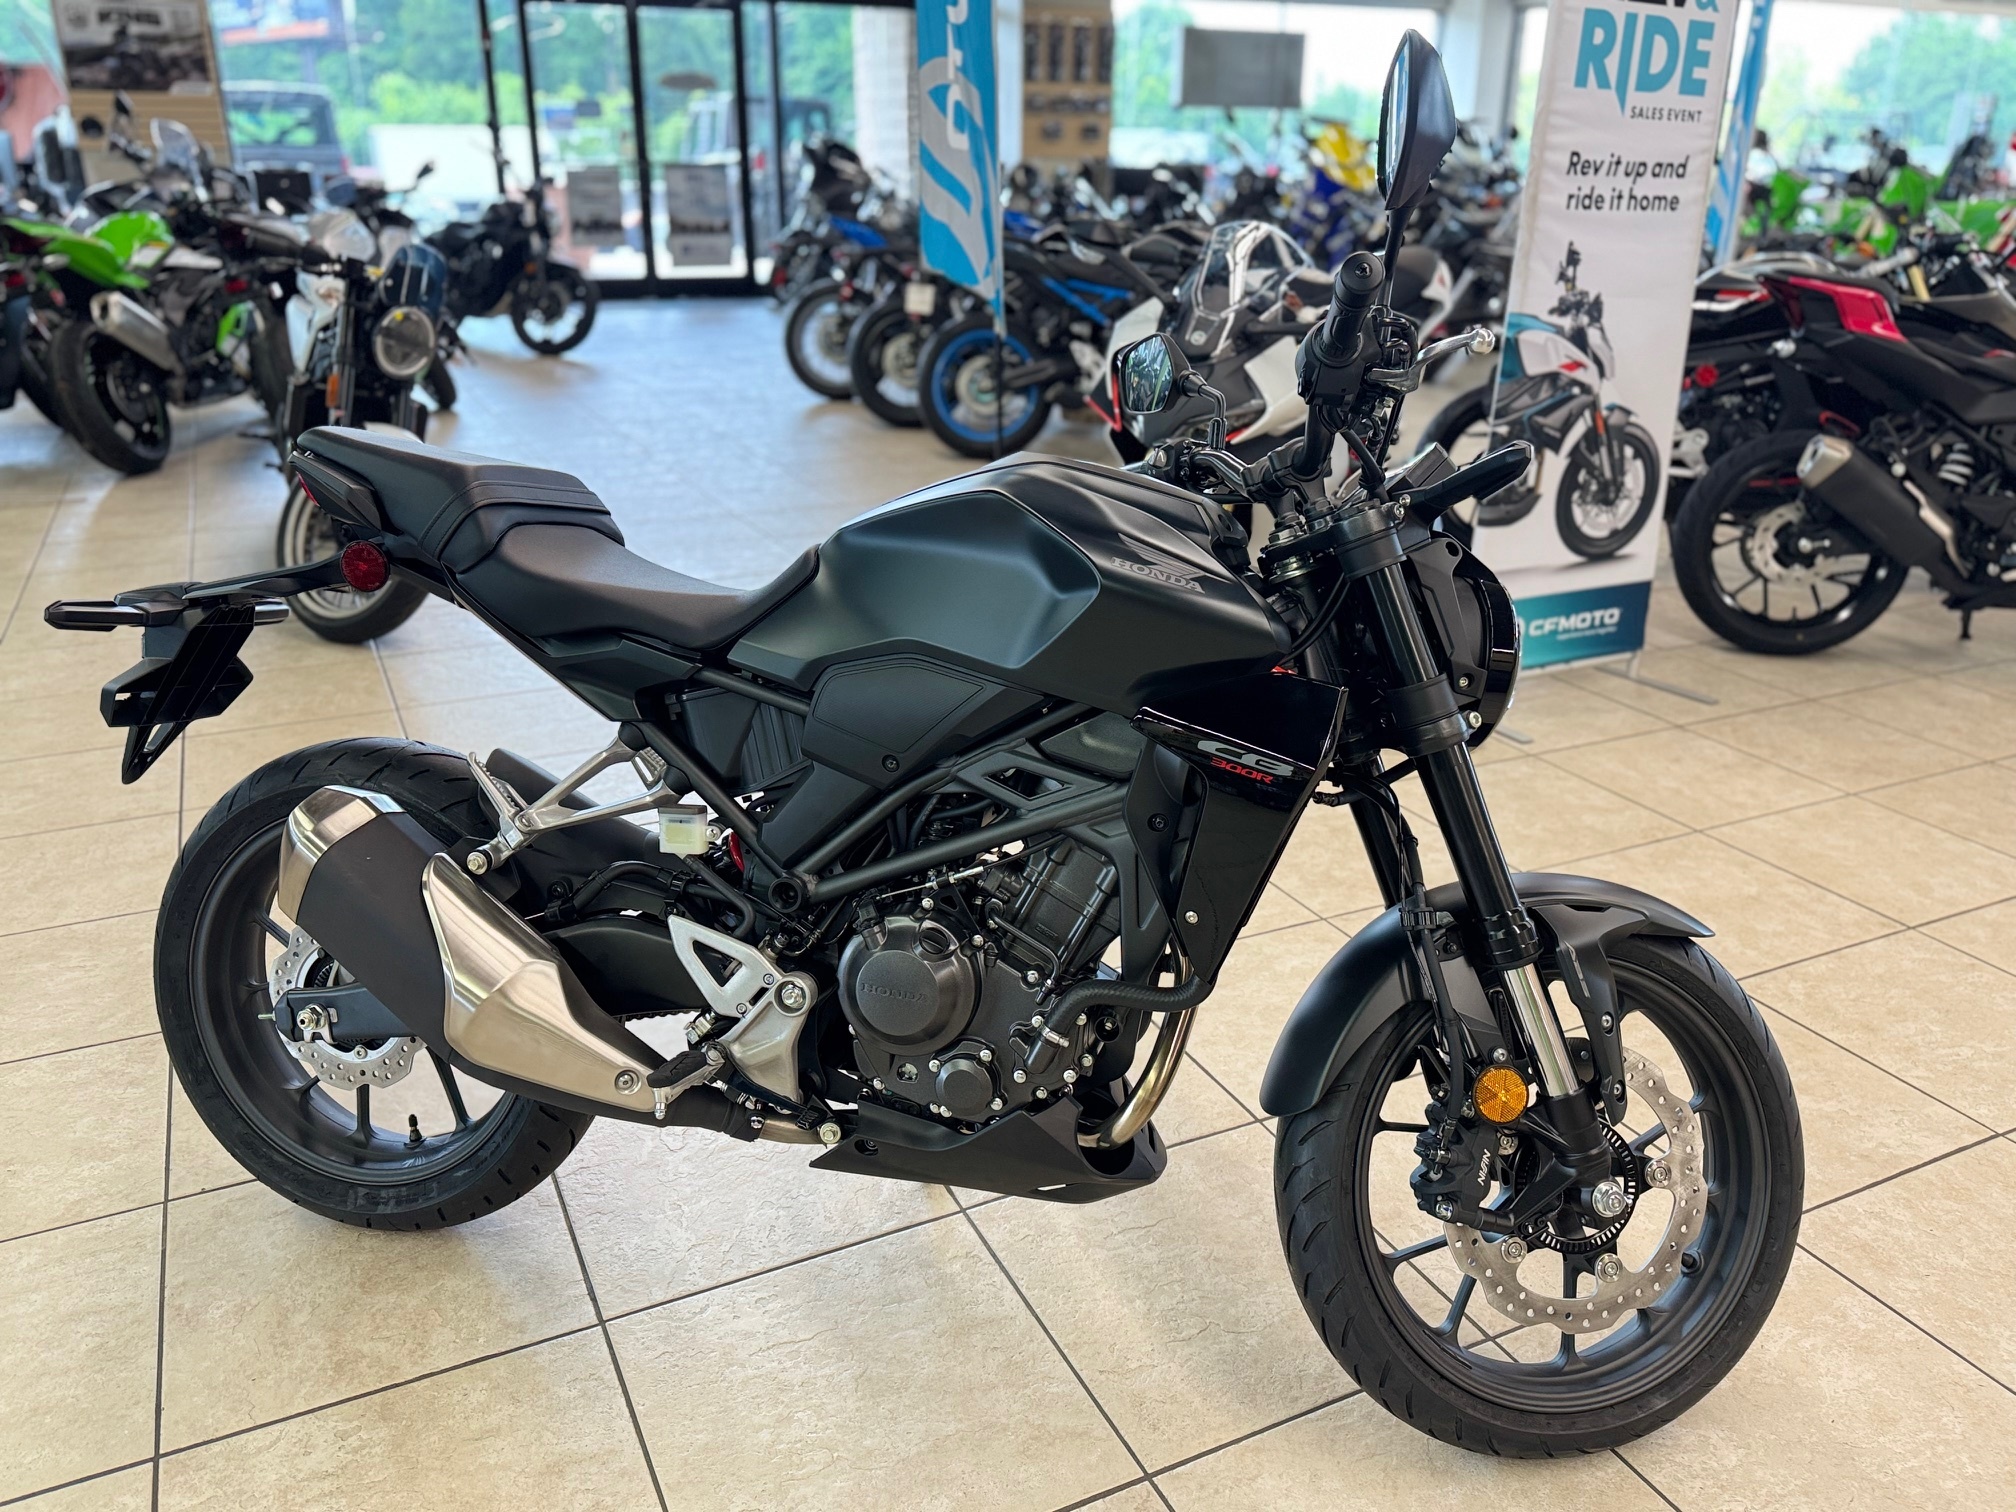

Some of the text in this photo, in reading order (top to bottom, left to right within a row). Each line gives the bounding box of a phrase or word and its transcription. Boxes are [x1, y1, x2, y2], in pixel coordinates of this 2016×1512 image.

[1574, 7, 1716, 117] RIDE
[1630, 106, 1703, 123] SALES EVENT
[1565, 150, 1690, 186] Rev it up and
[1565, 185, 1680, 212] ride it home
[1111, 556, 1206, 594] HONDA
[1528, 606, 1621, 638] CFMOTO
[1197, 740, 1294, 777] CB
[1210, 756, 1274, 784] 300R
[860, 982, 928, 1003] HONDA
